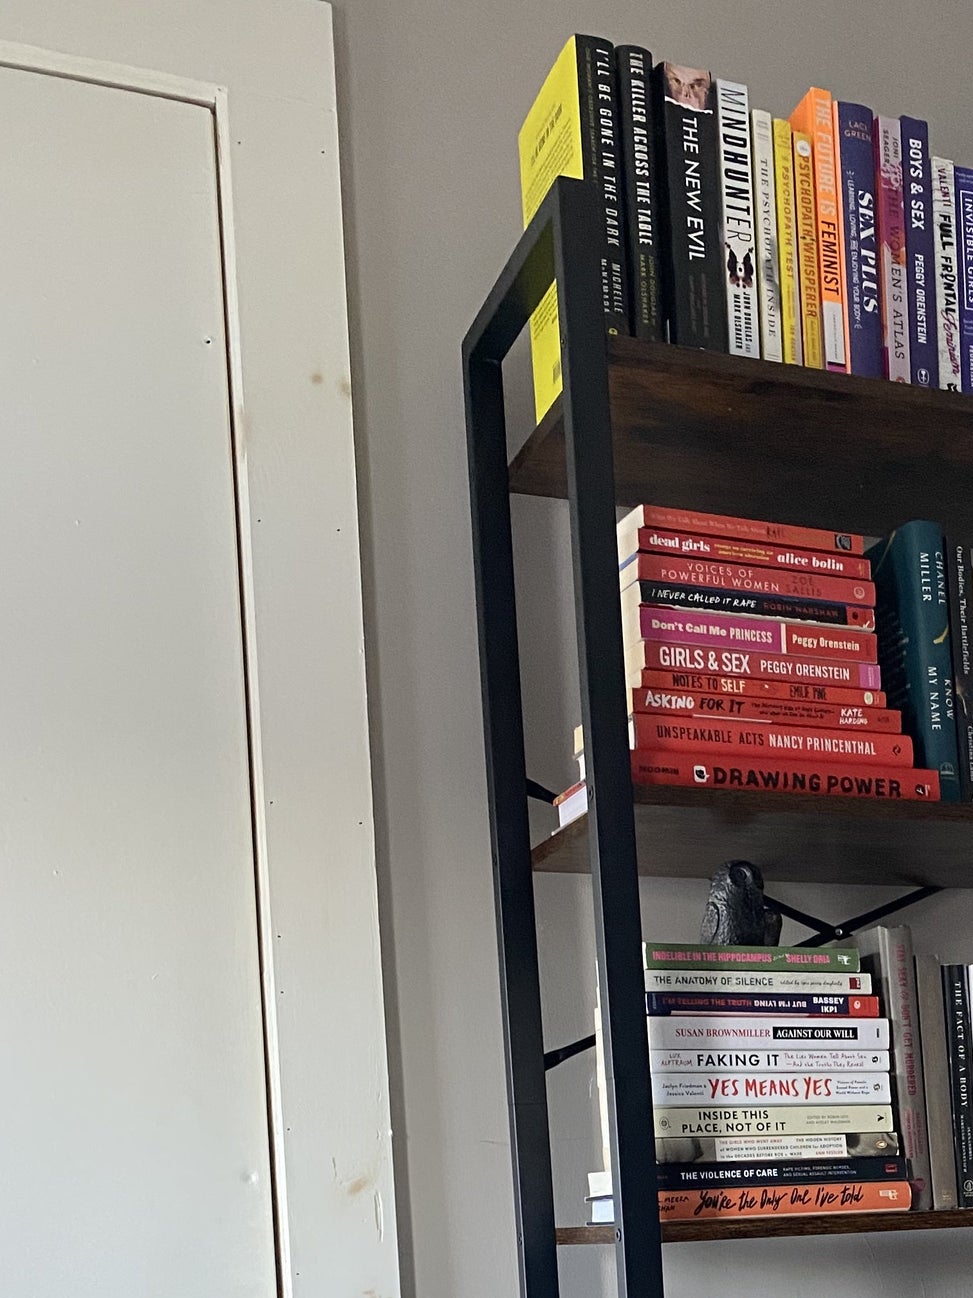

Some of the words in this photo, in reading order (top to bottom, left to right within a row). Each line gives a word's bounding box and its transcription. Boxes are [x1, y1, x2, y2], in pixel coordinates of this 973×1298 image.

[683, 116, 701, 151] THE
[720, 87, 751, 242] MINDHUNTER
[760, 159, 769, 185] THE
[909, 139, 922, 179] BOYS
[684, 159, 703, 213] NEW
[911, 184, 922, 195] &
[858, 190, 874, 242] SEX
[911, 199, 924, 230] SEX
[686, 216, 705, 260] EVIL
[762, 191, 773, 283] PSYCHOPATH
[861, 249, 878, 313] PLUS
[914, 254, 926, 286] PEGGY
[766, 288, 777, 337] INSIDE
[915, 290, 929, 343] ORENSTEIN
[649, 534, 678, 546] dead
[682, 538, 710, 553] girls
[777, 553, 808, 567] alice
[812, 556, 844, 570] bolin
[920, 552, 932, 601] MILLER
[935, 551, 946, 605] CHANEL
[660, 647, 704, 668] GIRLS
[708, 653, 719, 669] &
[722, 654, 751, 673] SEX
[760, 660, 792, 675] PEGGY
[796, 664, 850, 680] ORENSTEIN
[927, 666, 938, 688] MY
[929, 693, 942, 730] NAME
[943, 679, 954, 720] KNOW
[657, 726, 732, 743] UNSPEAKABLE
[739, 732, 764, 746] ACTS
[769, 734, 802, 750] NANCY
[807, 737, 876, 755] PRINCENTHAL
[713, 767, 820, 790] DRAWING
[827, 774, 901, 797] POWER
[675, 1028, 704, 1037] SUSAN
[706, 1029, 771, 1037] BROWNMILLER
[776, 1029, 812, 1038] AGAINST
[814, 1029, 831, 1038] OUR
[833, 1029, 855, 1038] WILL
[697, 1055, 760, 1067] FAKING
[767, 1055, 779, 1066] IT
[709, 1079, 739, 1098] YES
[745, 1081, 799, 1097] MEANS
[804, 1079, 832, 1097] YES
[682, 1123, 722, 1133] PLACE,
[727, 1123, 752, 1132] NOT
[755, 1123, 770, 1131] OF
[775, 1122, 786, 1130] IT
[698, 1111, 738, 1120] INSIDE
[742, 1110, 769, 1119] THIS
